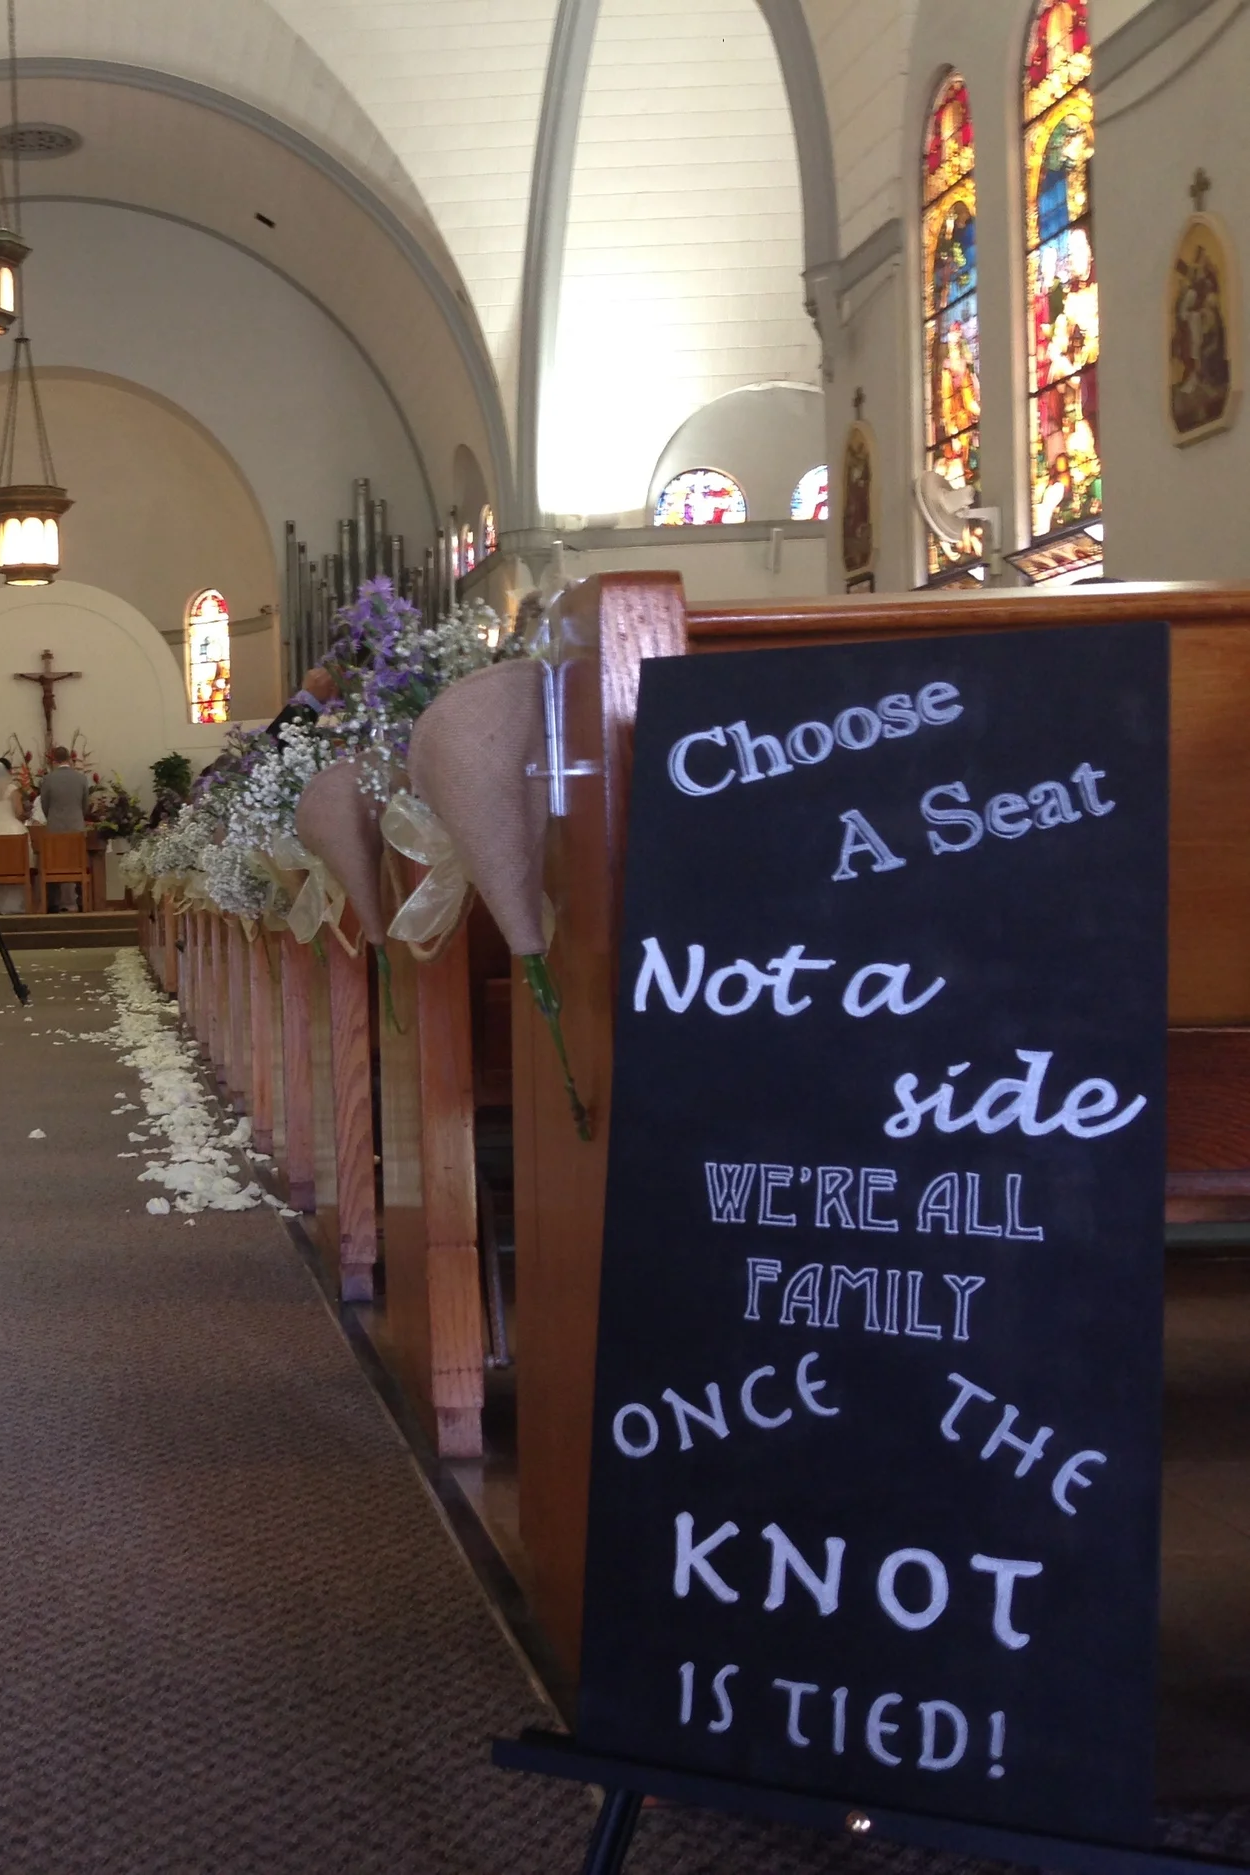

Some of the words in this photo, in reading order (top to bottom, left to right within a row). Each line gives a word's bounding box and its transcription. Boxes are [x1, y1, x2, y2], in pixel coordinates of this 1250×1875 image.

[667, 682, 964, 796] Choose
[832, 809, 906, 881] A
[921, 763, 1115, 855] Seat
[634, 937, 836, 1016] Not
[842, 963, 946, 1017] a
[884, 1049, 1147, 1138] side
[705, 1162, 898, 1232] WE'RE
[916, 1172, 1043, 1241] ALL
[744, 1258, 985, 1340] FAMILY
[614, 1352, 839, 1457] ONCE
[941, 1373, 1106, 1514] THE
[674, 1512, 1043, 1649] KNOT
[681, 1662, 738, 1731] IS
[775, 1679, 1004, 1777] TIED!
